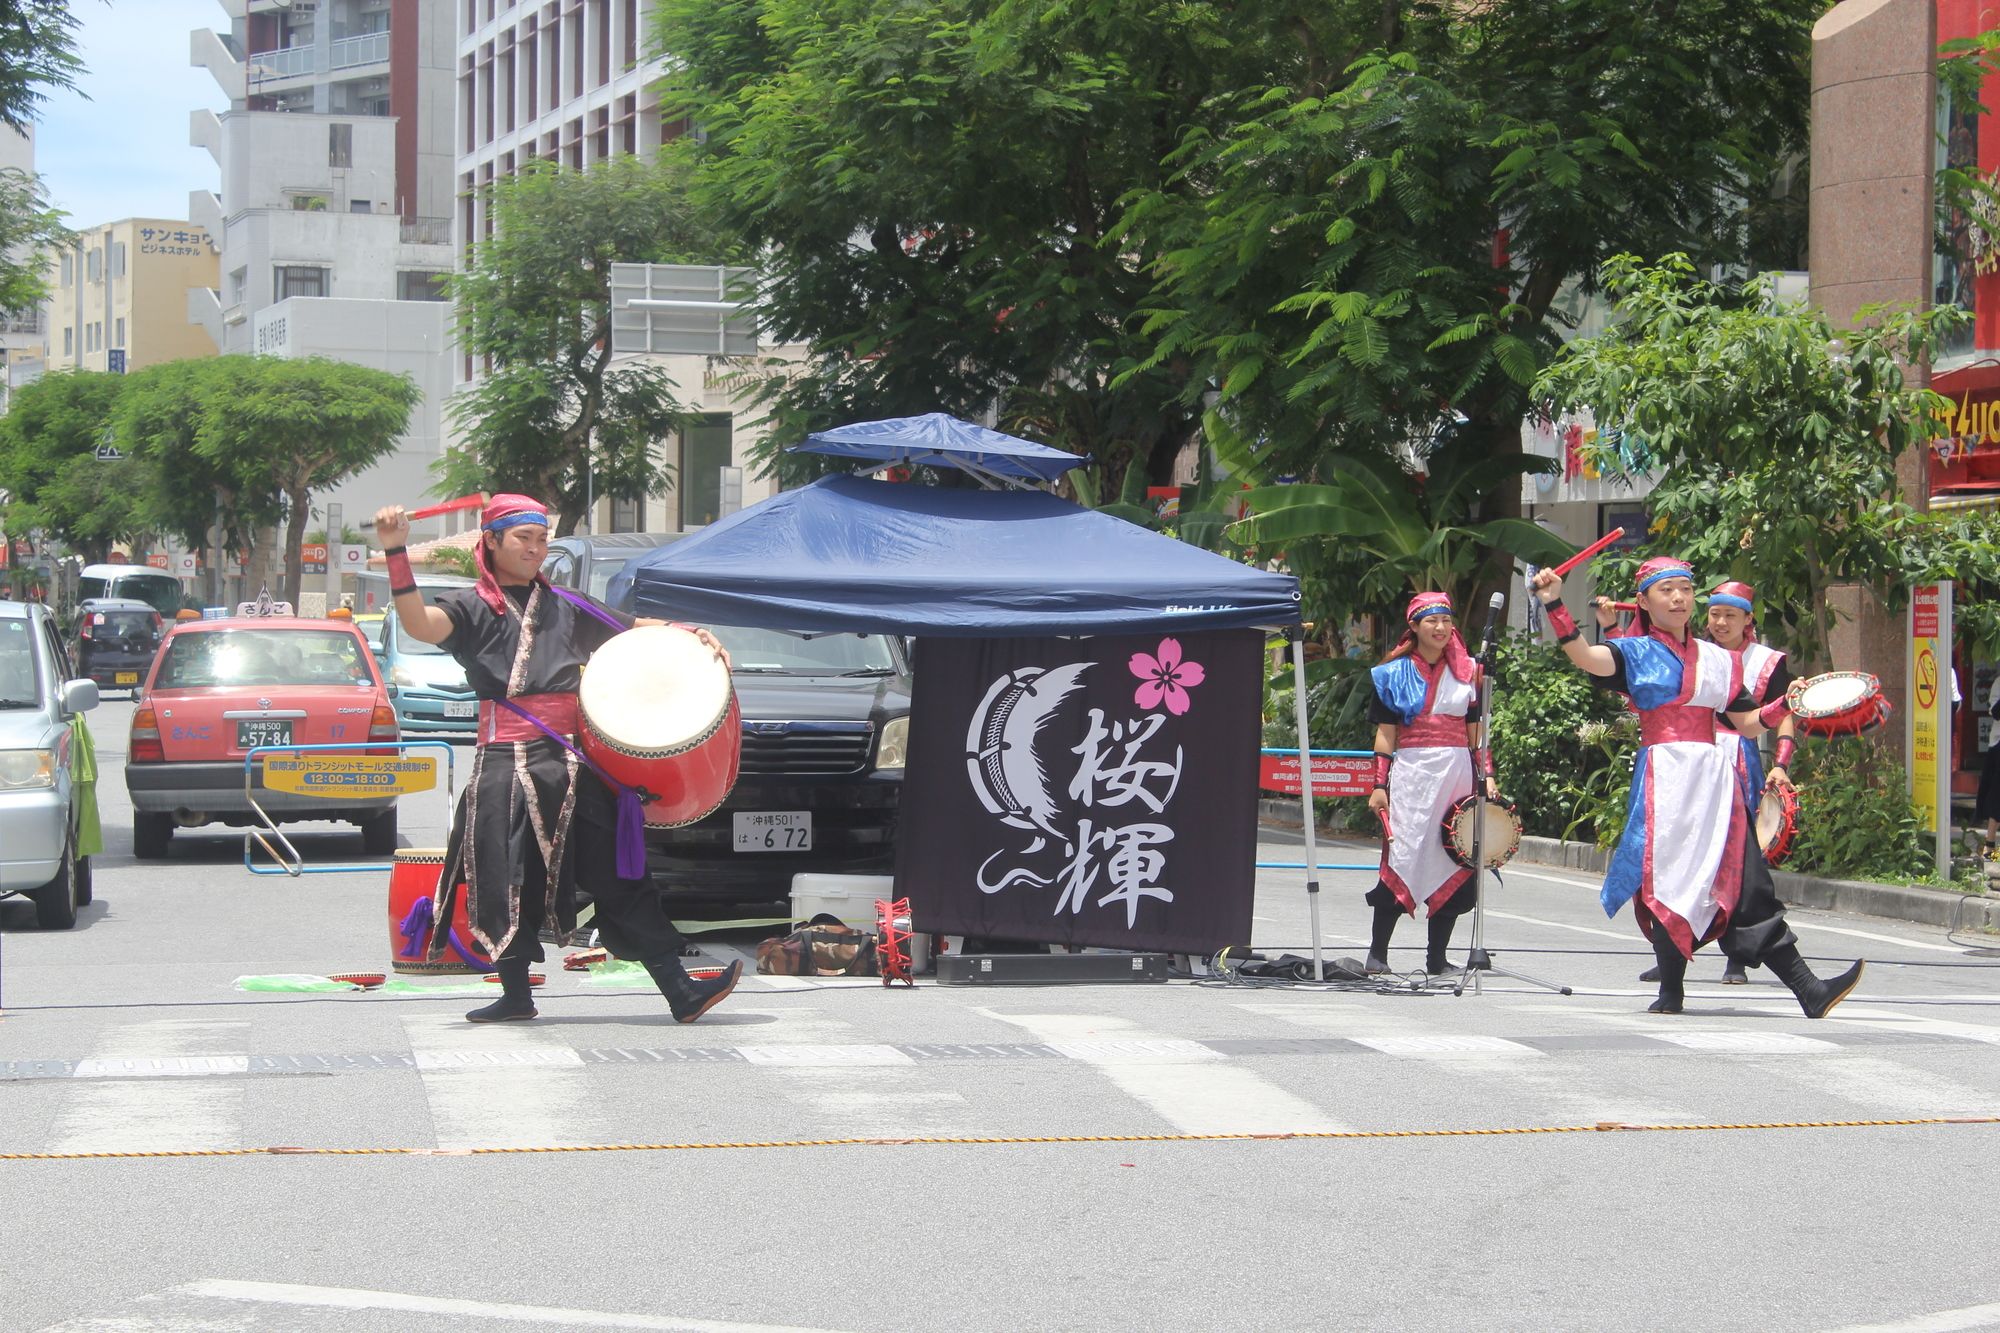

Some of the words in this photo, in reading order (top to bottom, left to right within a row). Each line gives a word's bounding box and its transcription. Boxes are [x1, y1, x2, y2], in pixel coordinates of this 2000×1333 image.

[141, 244, 201, 256] ビジネスホテル
[244, 603, 286, 616] さんご
[249, 731, 291, 747] 57-84
[269, 760, 431, 774] 国際通りトランジットモール交通規制中
[752, 815, 794, 826] 沖縄501
[738, 834, 749, 844] は
